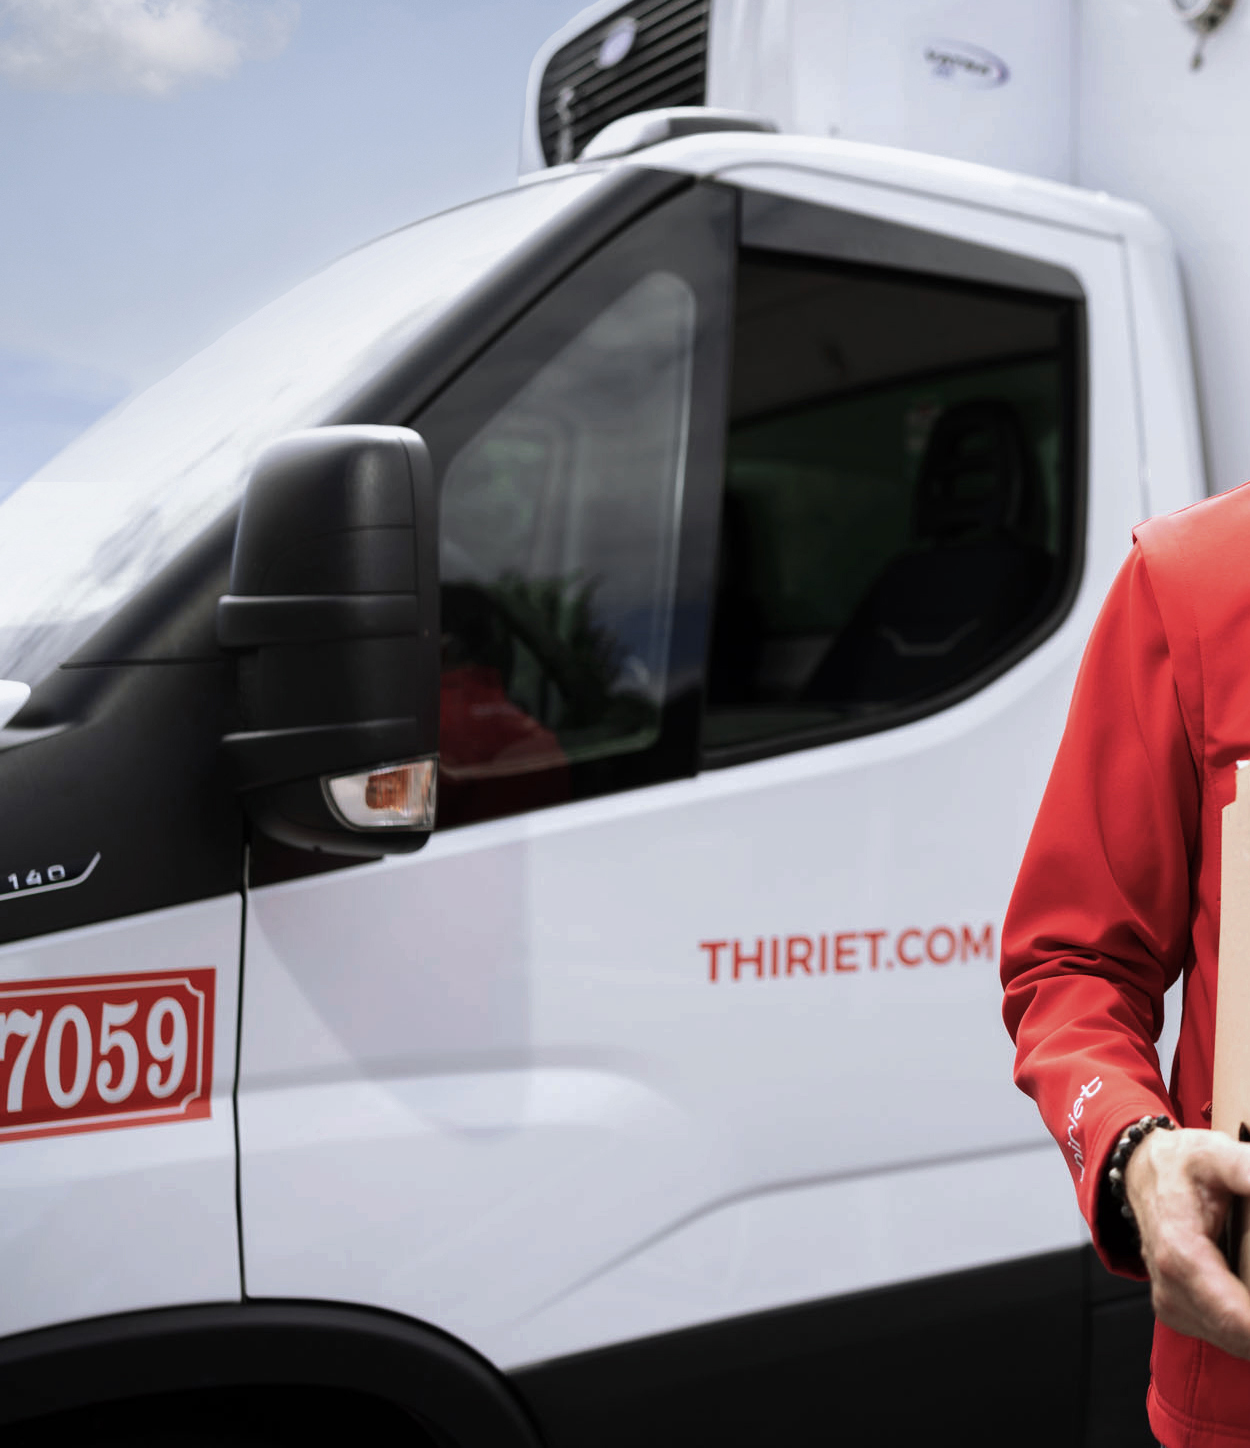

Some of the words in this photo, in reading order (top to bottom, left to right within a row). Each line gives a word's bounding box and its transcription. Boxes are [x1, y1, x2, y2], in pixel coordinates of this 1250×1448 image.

[8, 864, 65, 890] 140
[699, 922, 995, 984] THIRIET.COM
[0, 997, 188, 1113] 7059
